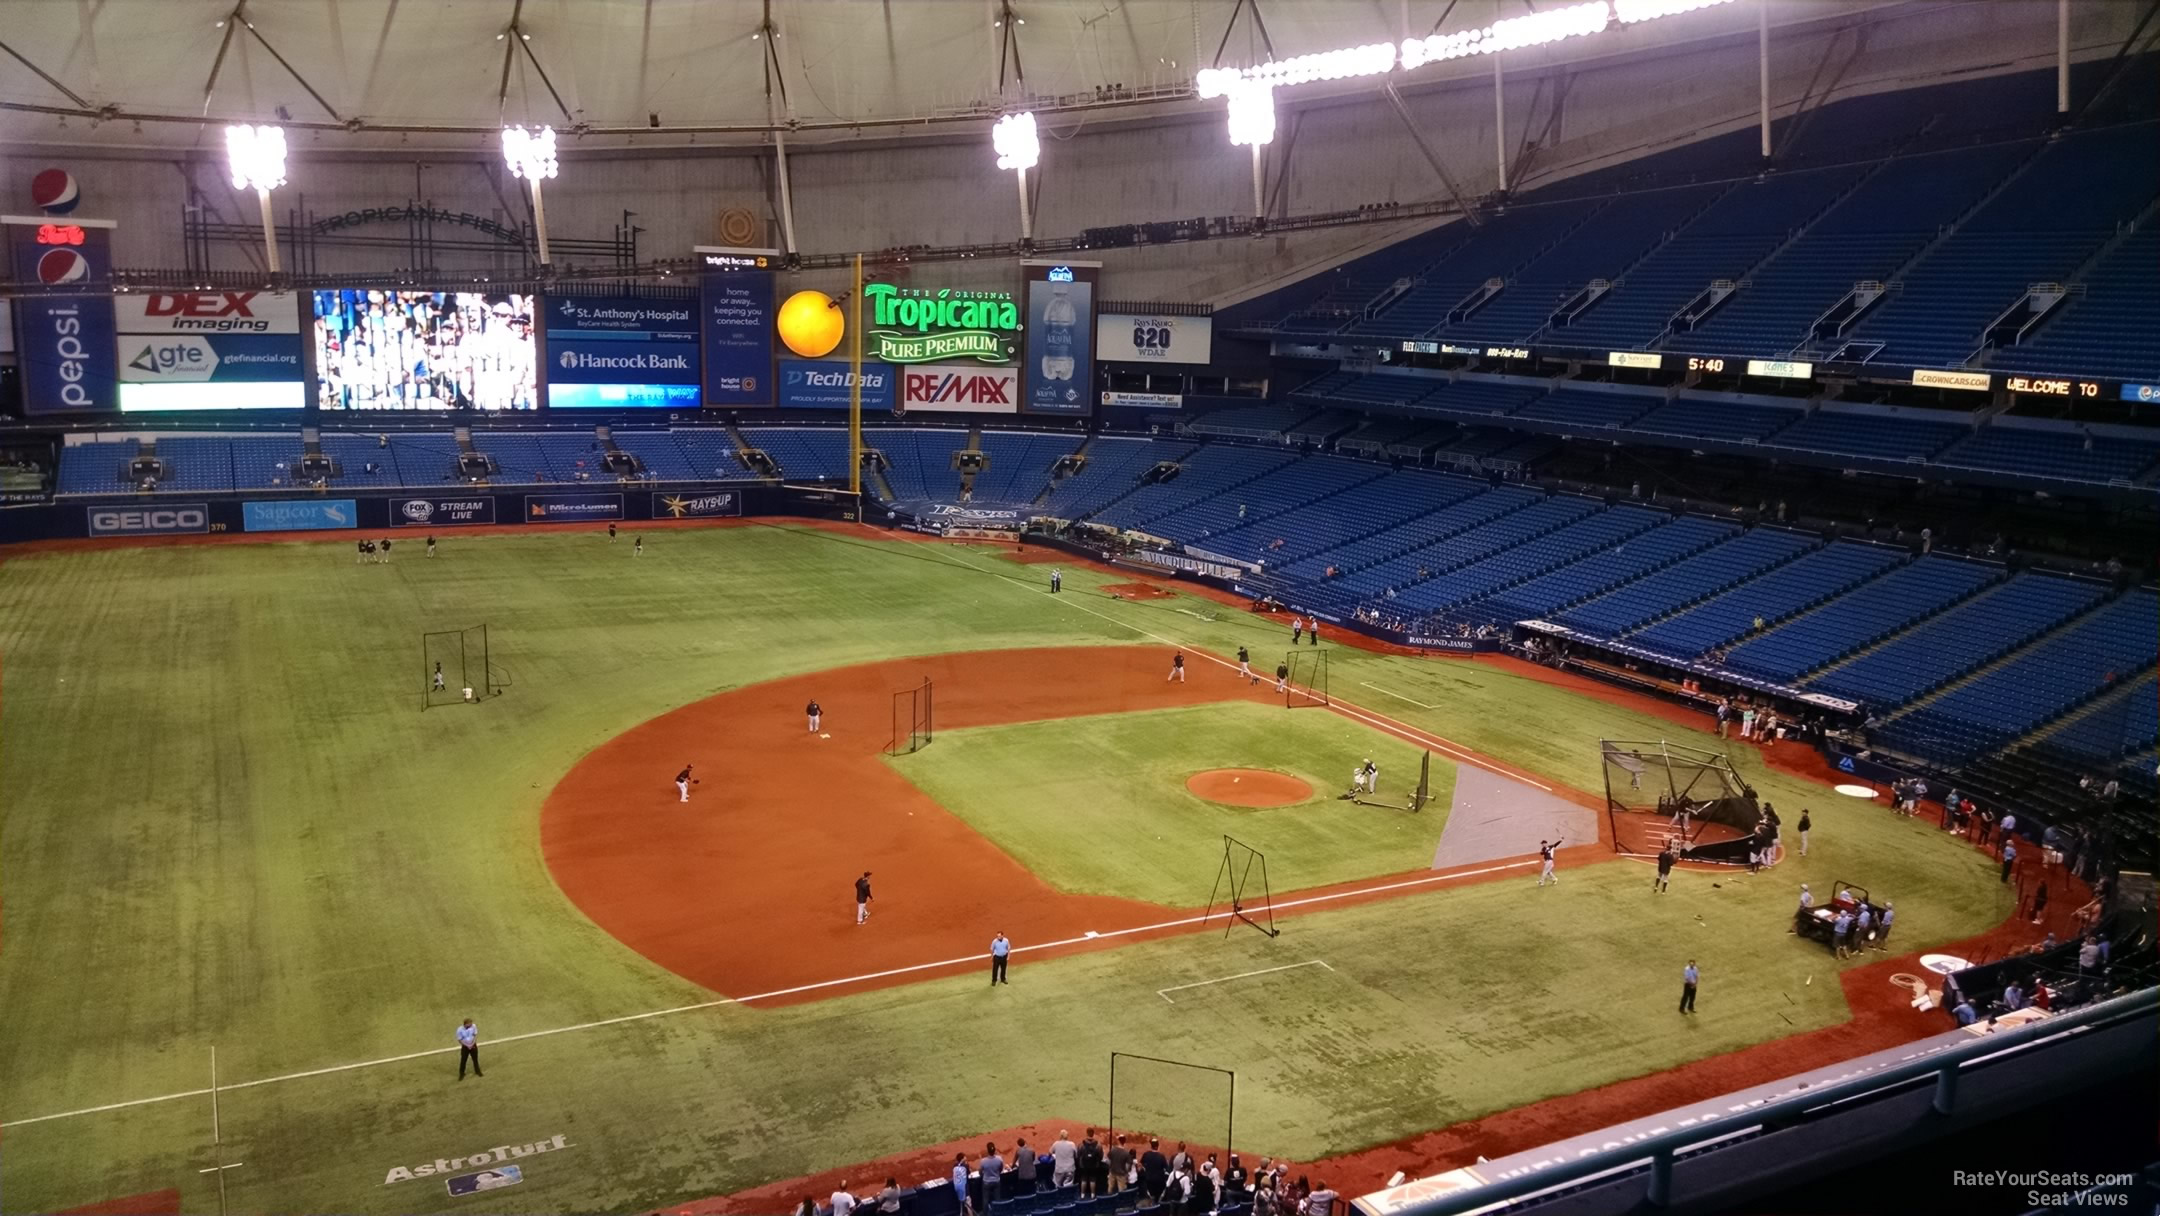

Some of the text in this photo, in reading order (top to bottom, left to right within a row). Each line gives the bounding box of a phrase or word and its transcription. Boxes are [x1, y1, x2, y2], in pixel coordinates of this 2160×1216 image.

[315, 206, 453, 235] TROPICANA
[726, 287, 750, 296] home
[902, 289, 1012, 300] THE ORIGINAL
[144, 291, 259, 317] DEX
[714, 306, 762, 317] keeping you
[864, 283, 1017, 332] Tropicana
[577, 308, 689, 322] St. Anthony's Hospital
[716, 317, 761, 326] connected.
[172, 317, 270, 332] imaging
[1133, 327, 1171, 349] 620
[881, 336, 998, 358] PURE PREMIUM
[1137, 348, 1166, 357] WDAE
[48, 309, 93, 405] pepsi
[159, 344, 204, 369] gte
[223, 353, 297, 365] gtefinancial.org
[579, 353, 689, 369] Hancock Bank
[1688, 357, 1724, 372] 5:40
[805, 371, 884, 388] Tech Data
[2006, 376, 2099, 397] WELCOME TO
[906, 373, 1011, 405] RE/MAX
[254, 504, 318, 522] Sagicor
[409, 503, 427, 511] FOX
[440, 501, 483, 512] STREAM
[93, 510, 204, 531] GEICO
[451, 510, 473, 520] LIVE
[210, 523, 227, 531] 370
[1408, 636, 1474, 650] RAYMOND JAMES
[384, 1133, 568, 1186] AstroTurf
